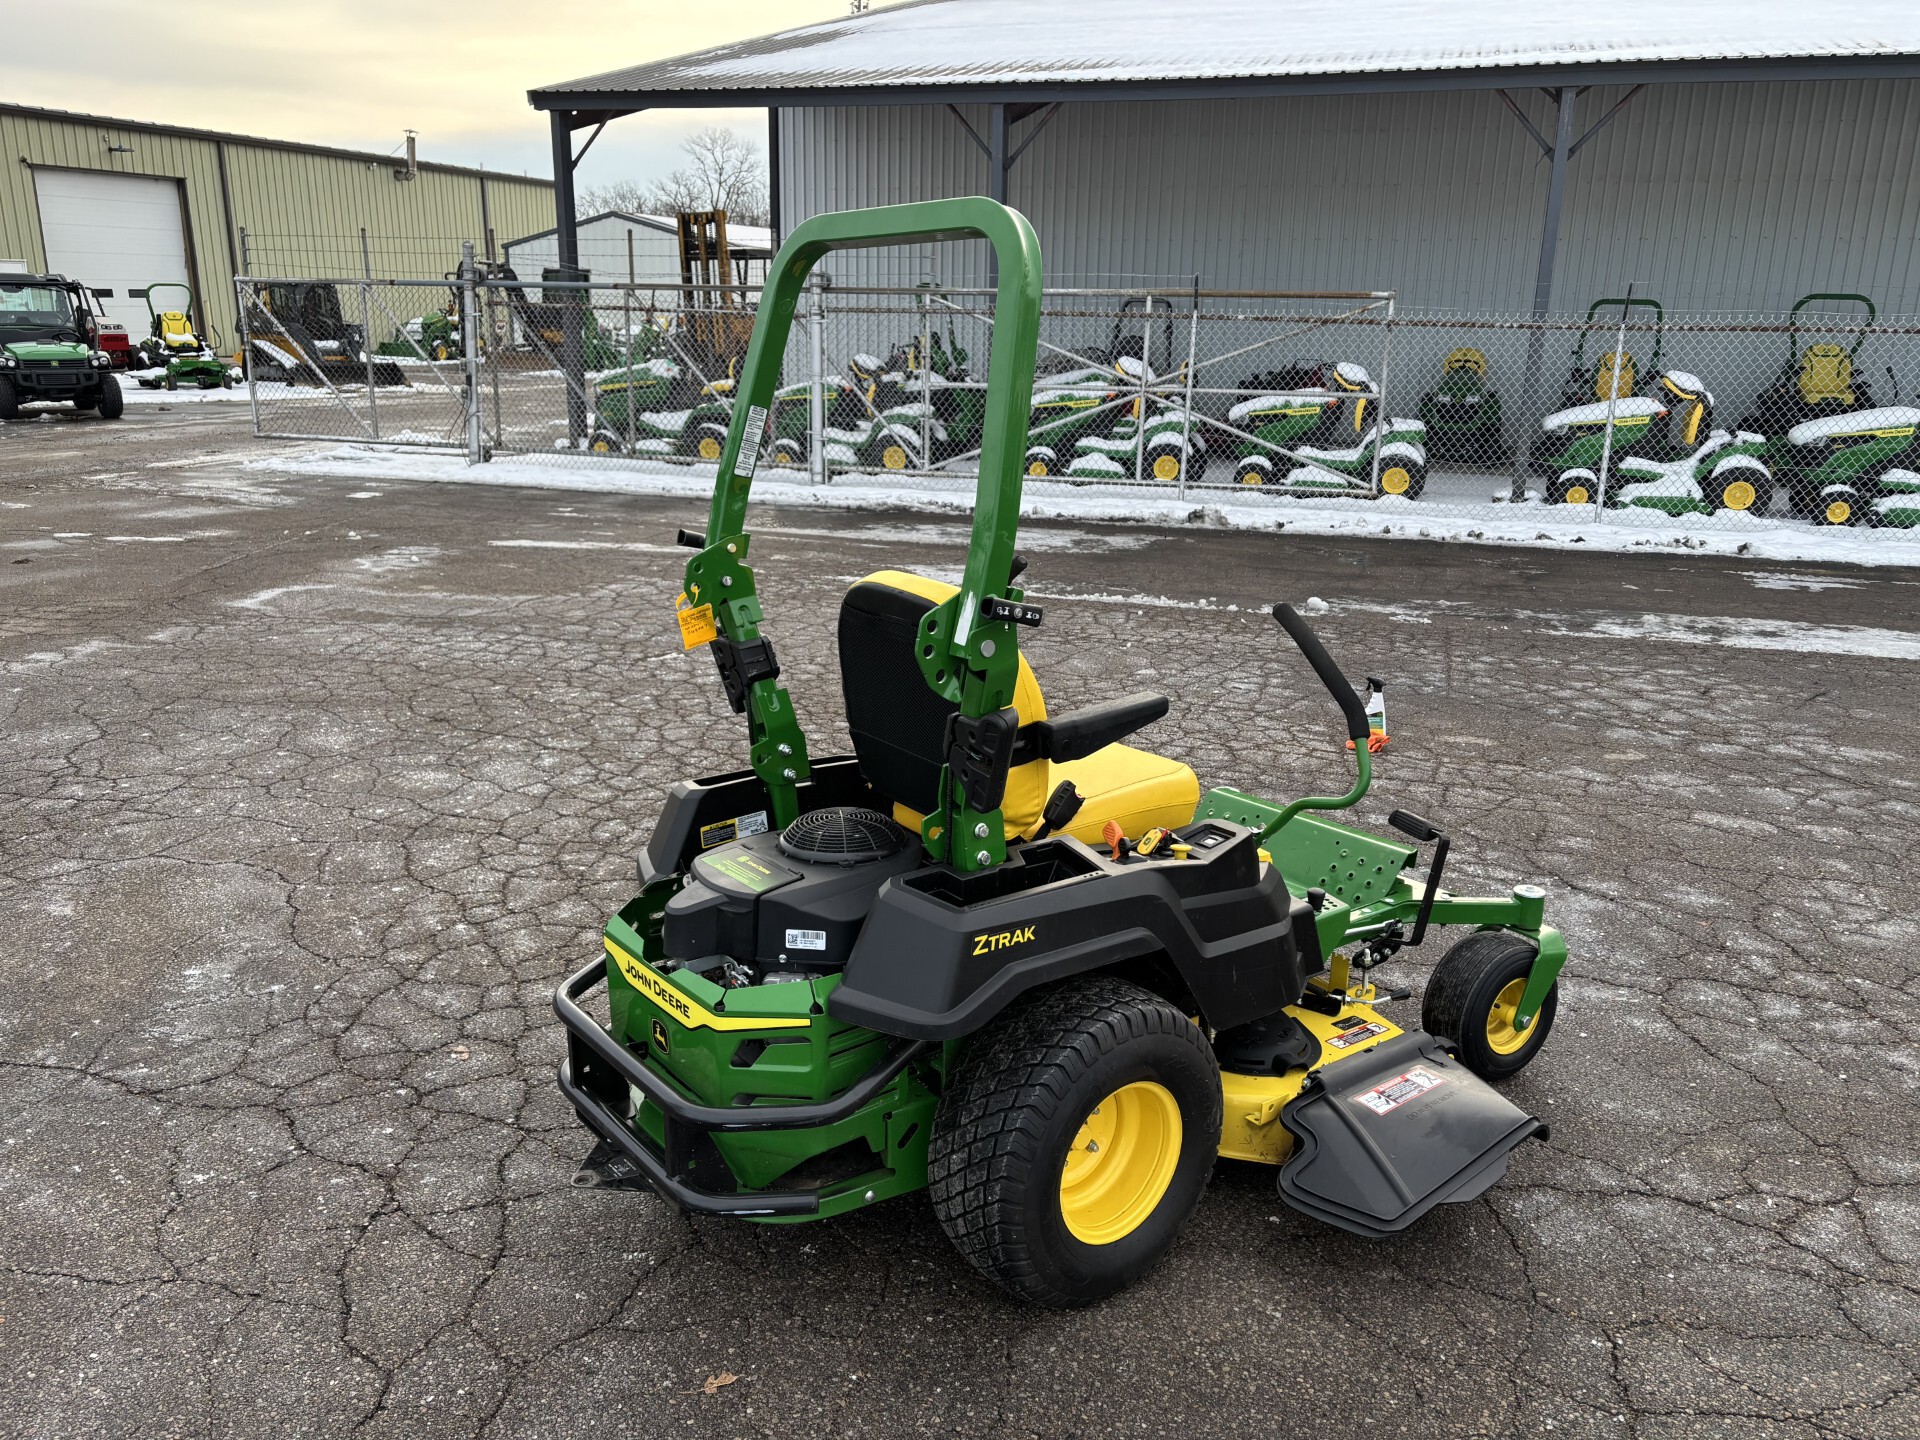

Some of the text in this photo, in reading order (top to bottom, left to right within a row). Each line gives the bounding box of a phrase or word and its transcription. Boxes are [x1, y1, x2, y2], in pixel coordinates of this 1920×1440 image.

[972, 925, 1036, 956] ZTRAK
[625, 960, 691, 1020] JOHN DEERE
